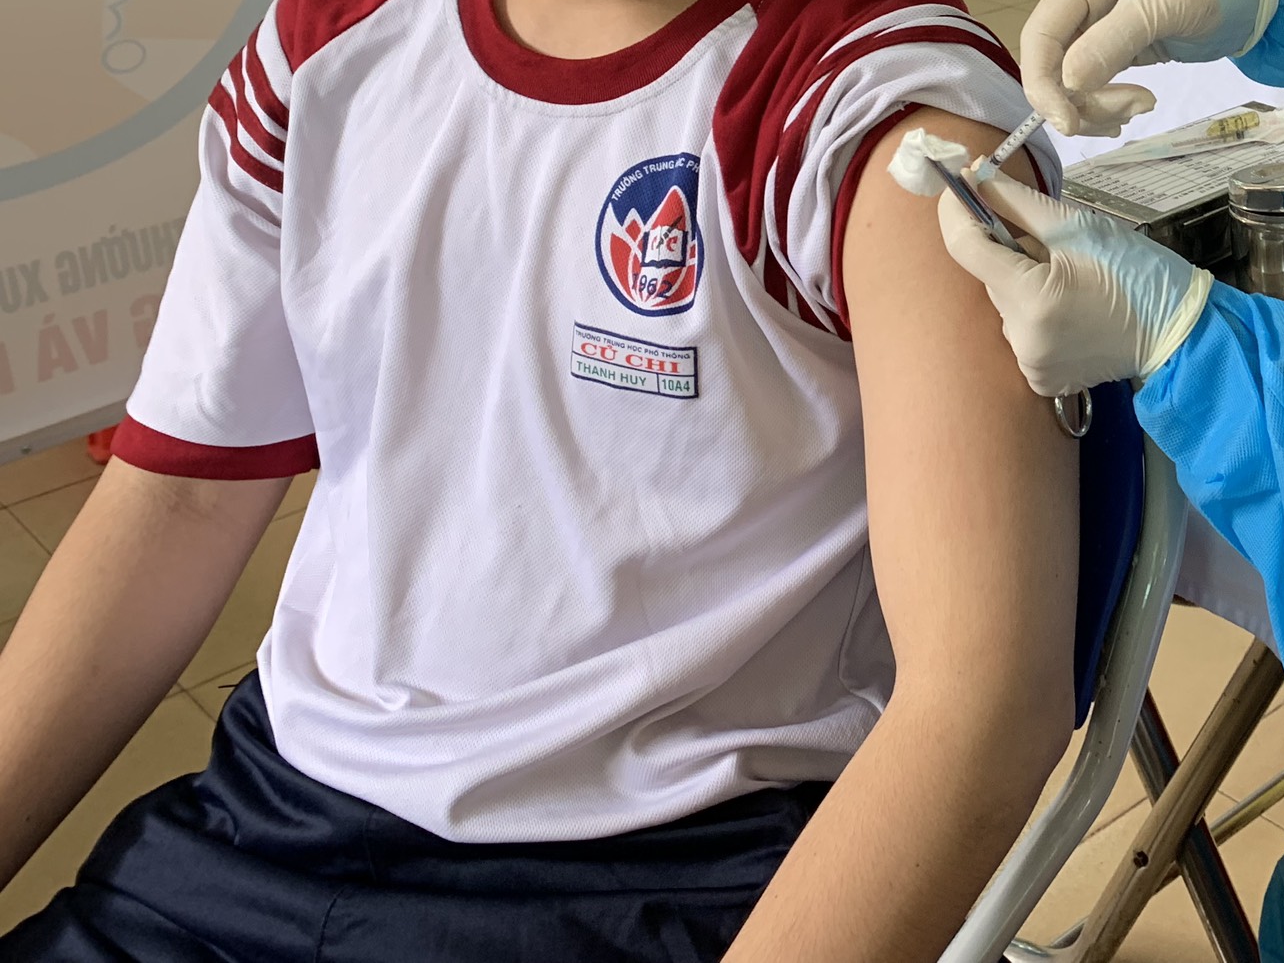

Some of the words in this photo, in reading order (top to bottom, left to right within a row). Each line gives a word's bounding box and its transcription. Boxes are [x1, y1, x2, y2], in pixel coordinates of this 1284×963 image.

[643, 160, 678, 177] TRUNG
[686, 160, 700, 173] PH
[632, 273, 673, 299] 1962
[603, 337, 626, 349] TRUNG
[581, 342, 618, 361] CỦ
[625, 354, 681, 373] CHI
[576, 360, 616, 381] THANH
[620, 372, 647, 386] HUY
[662, 378, 691, 392] 10A4
